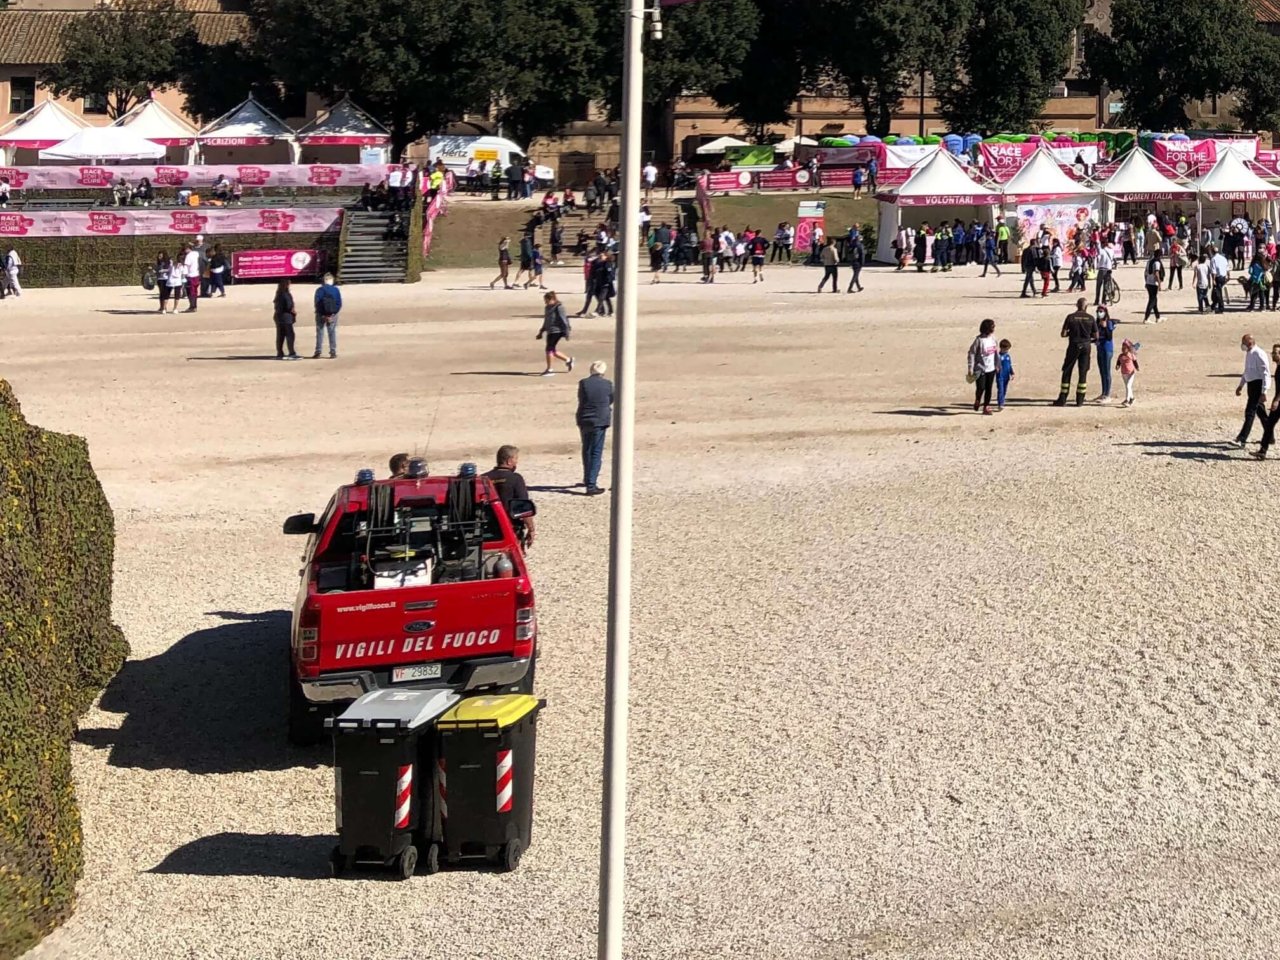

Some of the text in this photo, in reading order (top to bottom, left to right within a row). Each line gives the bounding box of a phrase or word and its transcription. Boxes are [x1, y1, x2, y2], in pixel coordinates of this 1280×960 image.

[441, 149, 468, 158] Hertz
[990, 146, 1022, 157] RACE
[1166, 152, 1207, 161] FOR THE
[925, 195, 974, 205] VOLONTARI
[1123, 192, 1173, 201] KOMEN ITALIA
[1219, 191, 1268, 200] KOMEN ITALIA
[335, 629, 500, 659] VIGILI DEL FUOCO
[395, 665, 440, 679] VF 29832
